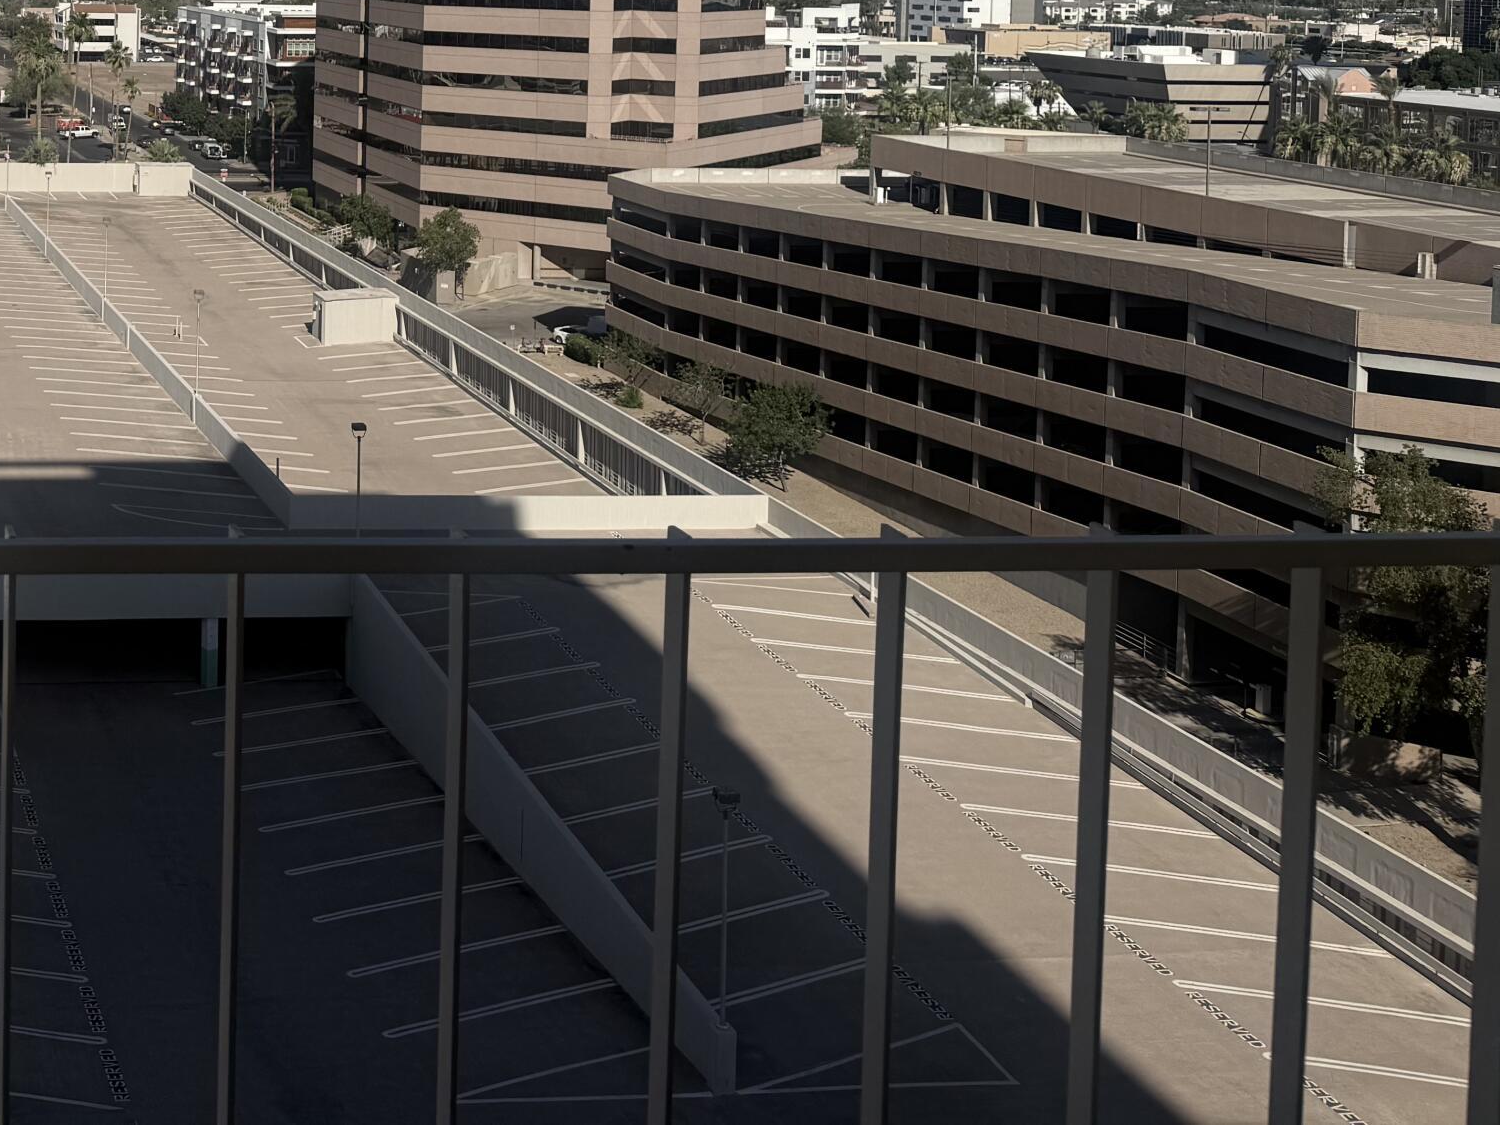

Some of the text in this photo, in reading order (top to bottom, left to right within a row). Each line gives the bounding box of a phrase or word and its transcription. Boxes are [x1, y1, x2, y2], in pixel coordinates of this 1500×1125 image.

[904, 763, 958, 803] RESERVED
[961, 810, 1022, 853] RESERVED
[1028, 863, 1077, 905] RESERV
[61, 929, 88, 972] RESERVED
[1104, 924, 1174, 977] RESERVED
[79, 985, 108, 1033] RESERVED
[1184, 990, 1267, 1049] RESERVED
[98, 1048, 131, 1102] RESERVED
